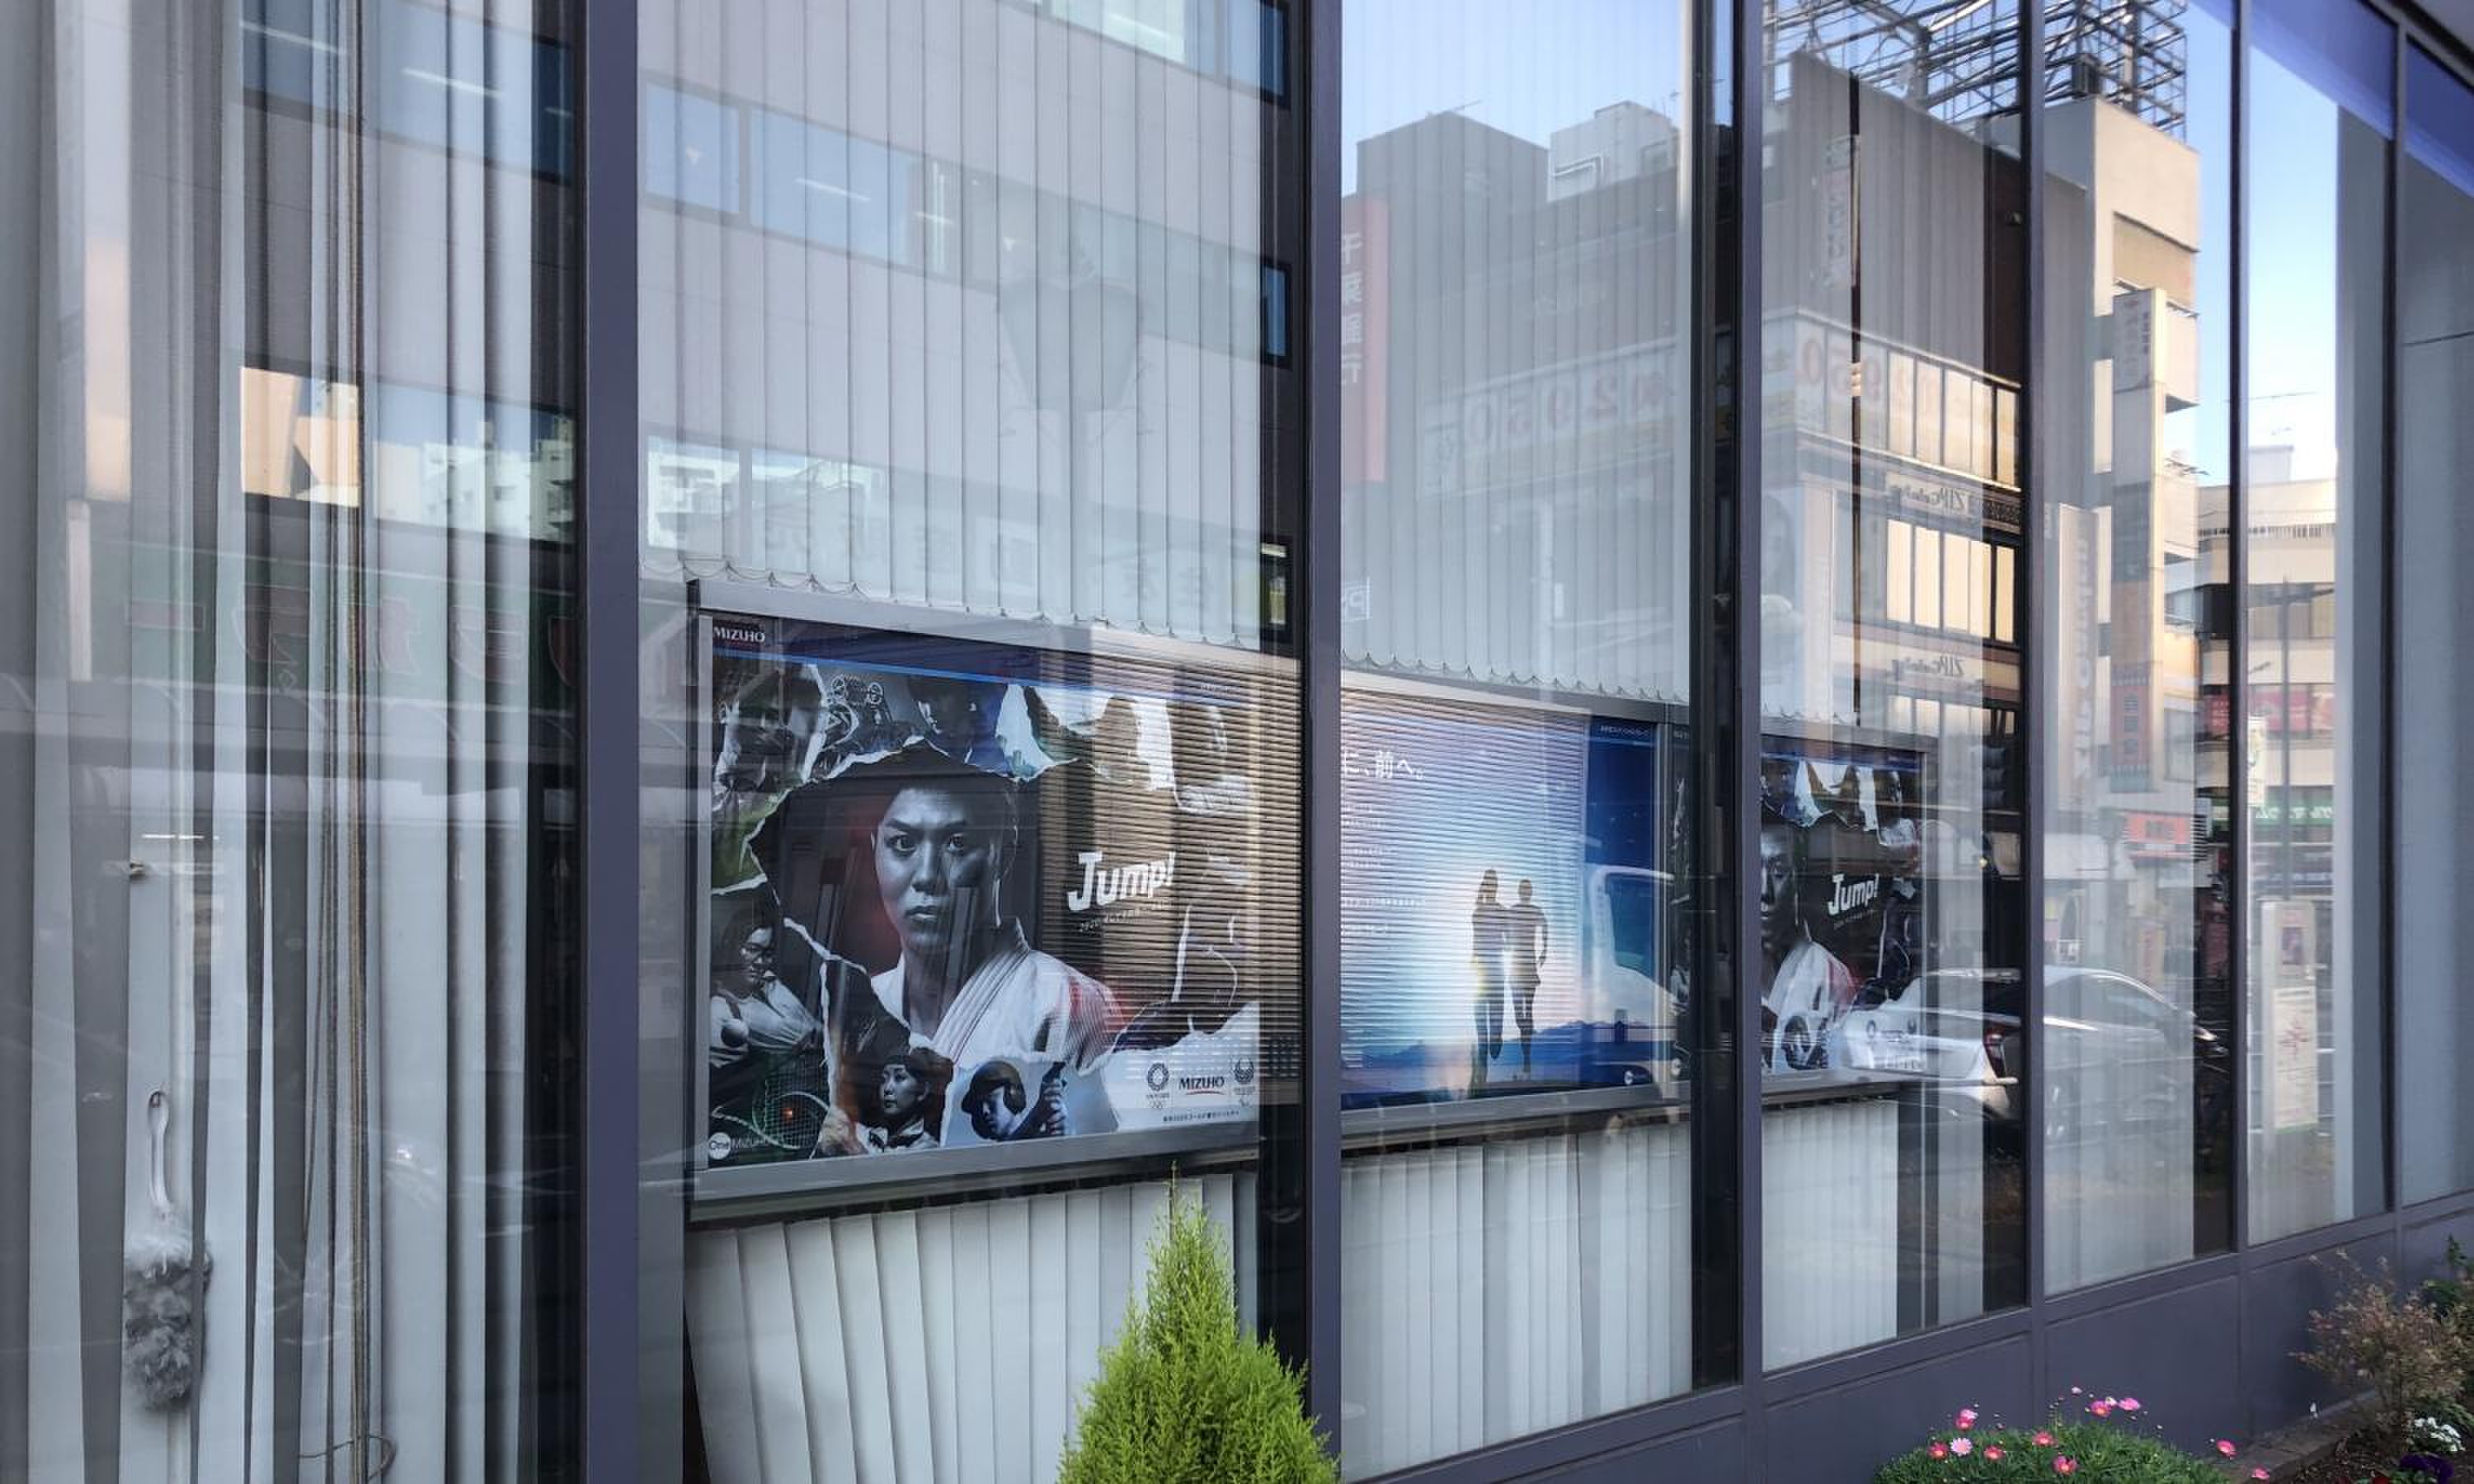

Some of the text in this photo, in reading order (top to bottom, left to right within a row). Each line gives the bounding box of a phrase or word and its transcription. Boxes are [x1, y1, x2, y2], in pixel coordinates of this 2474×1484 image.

[713, 626, 766, 642] MIZUHO
[1068, 850, 1176, 911] Jump!
[1827, 873, 1879, 915] Jump!
[1178, 1075, 1225, 1091] MIZUHO
